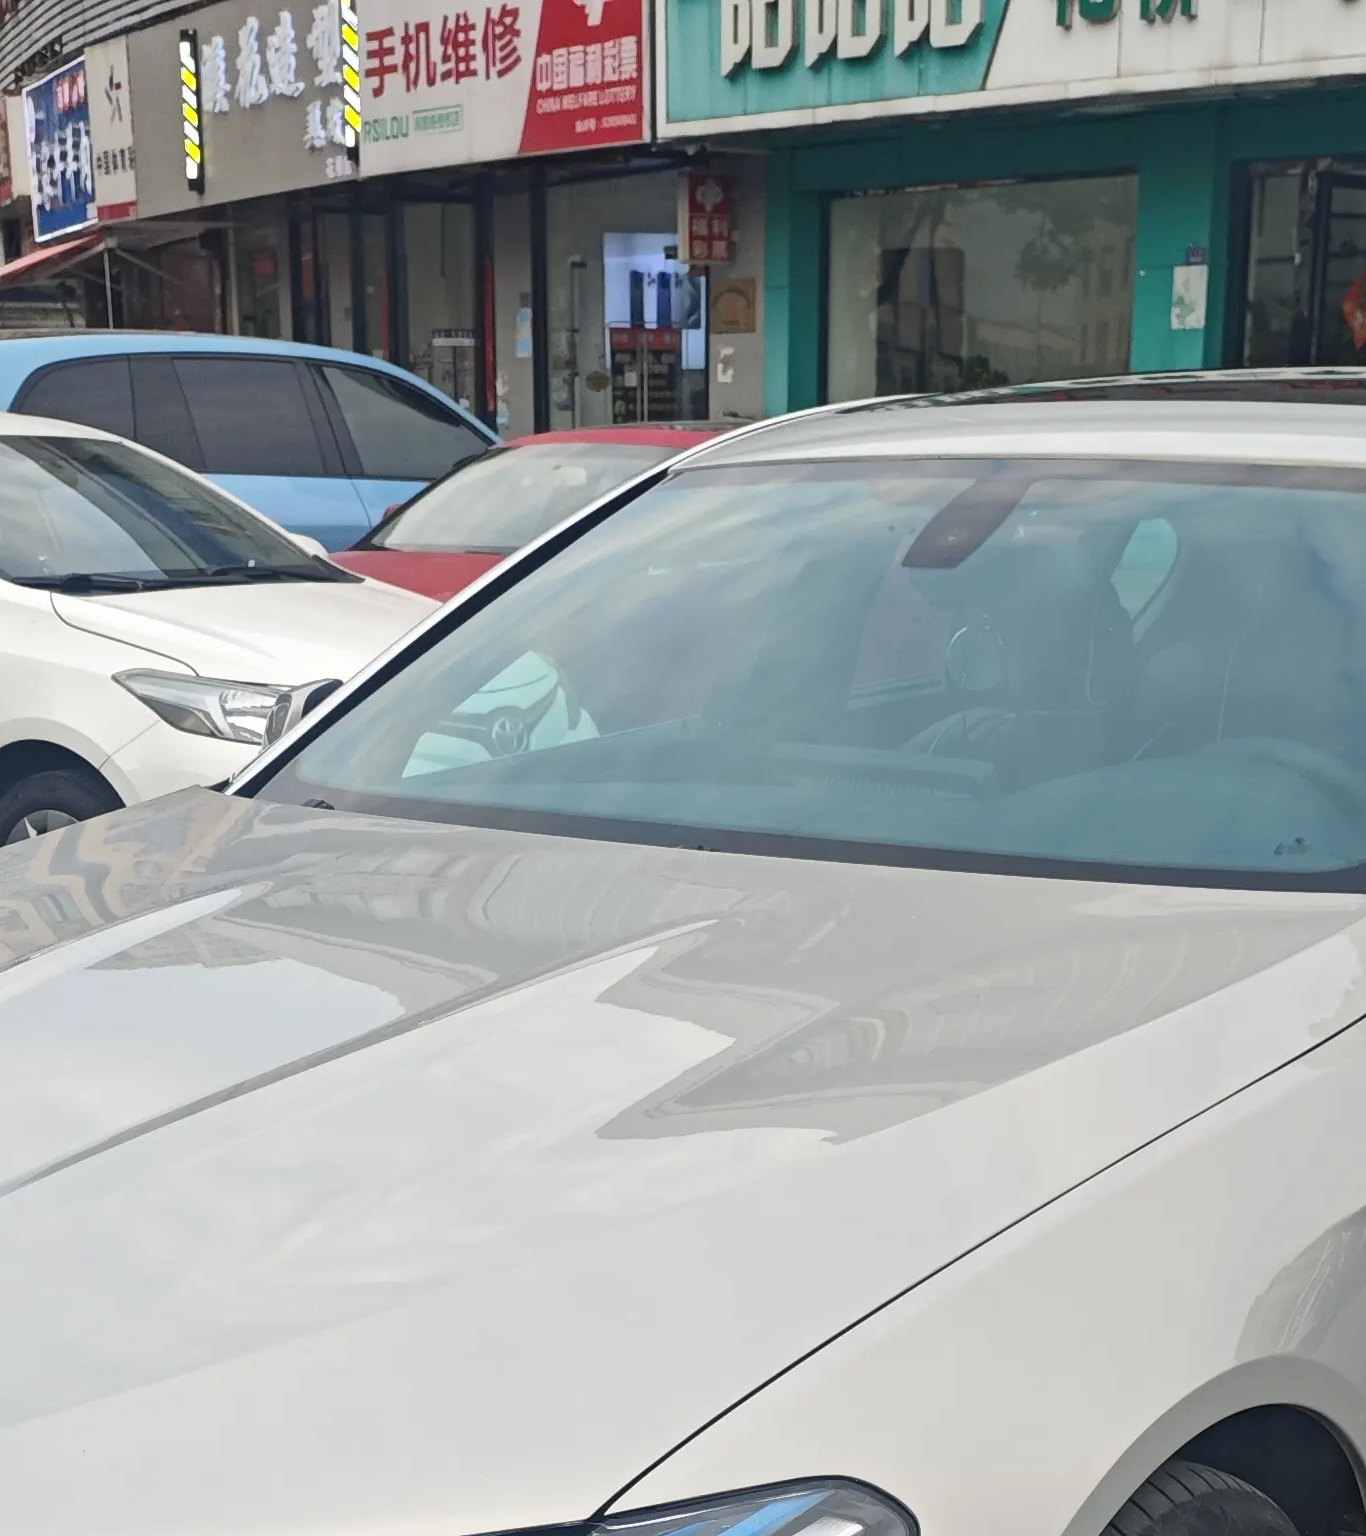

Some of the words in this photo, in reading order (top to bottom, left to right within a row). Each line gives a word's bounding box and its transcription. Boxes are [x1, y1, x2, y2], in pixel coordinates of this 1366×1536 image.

[364, 3, 522, 98] 手机维修
[536, 36, 638, 92] 中国福利彩票
